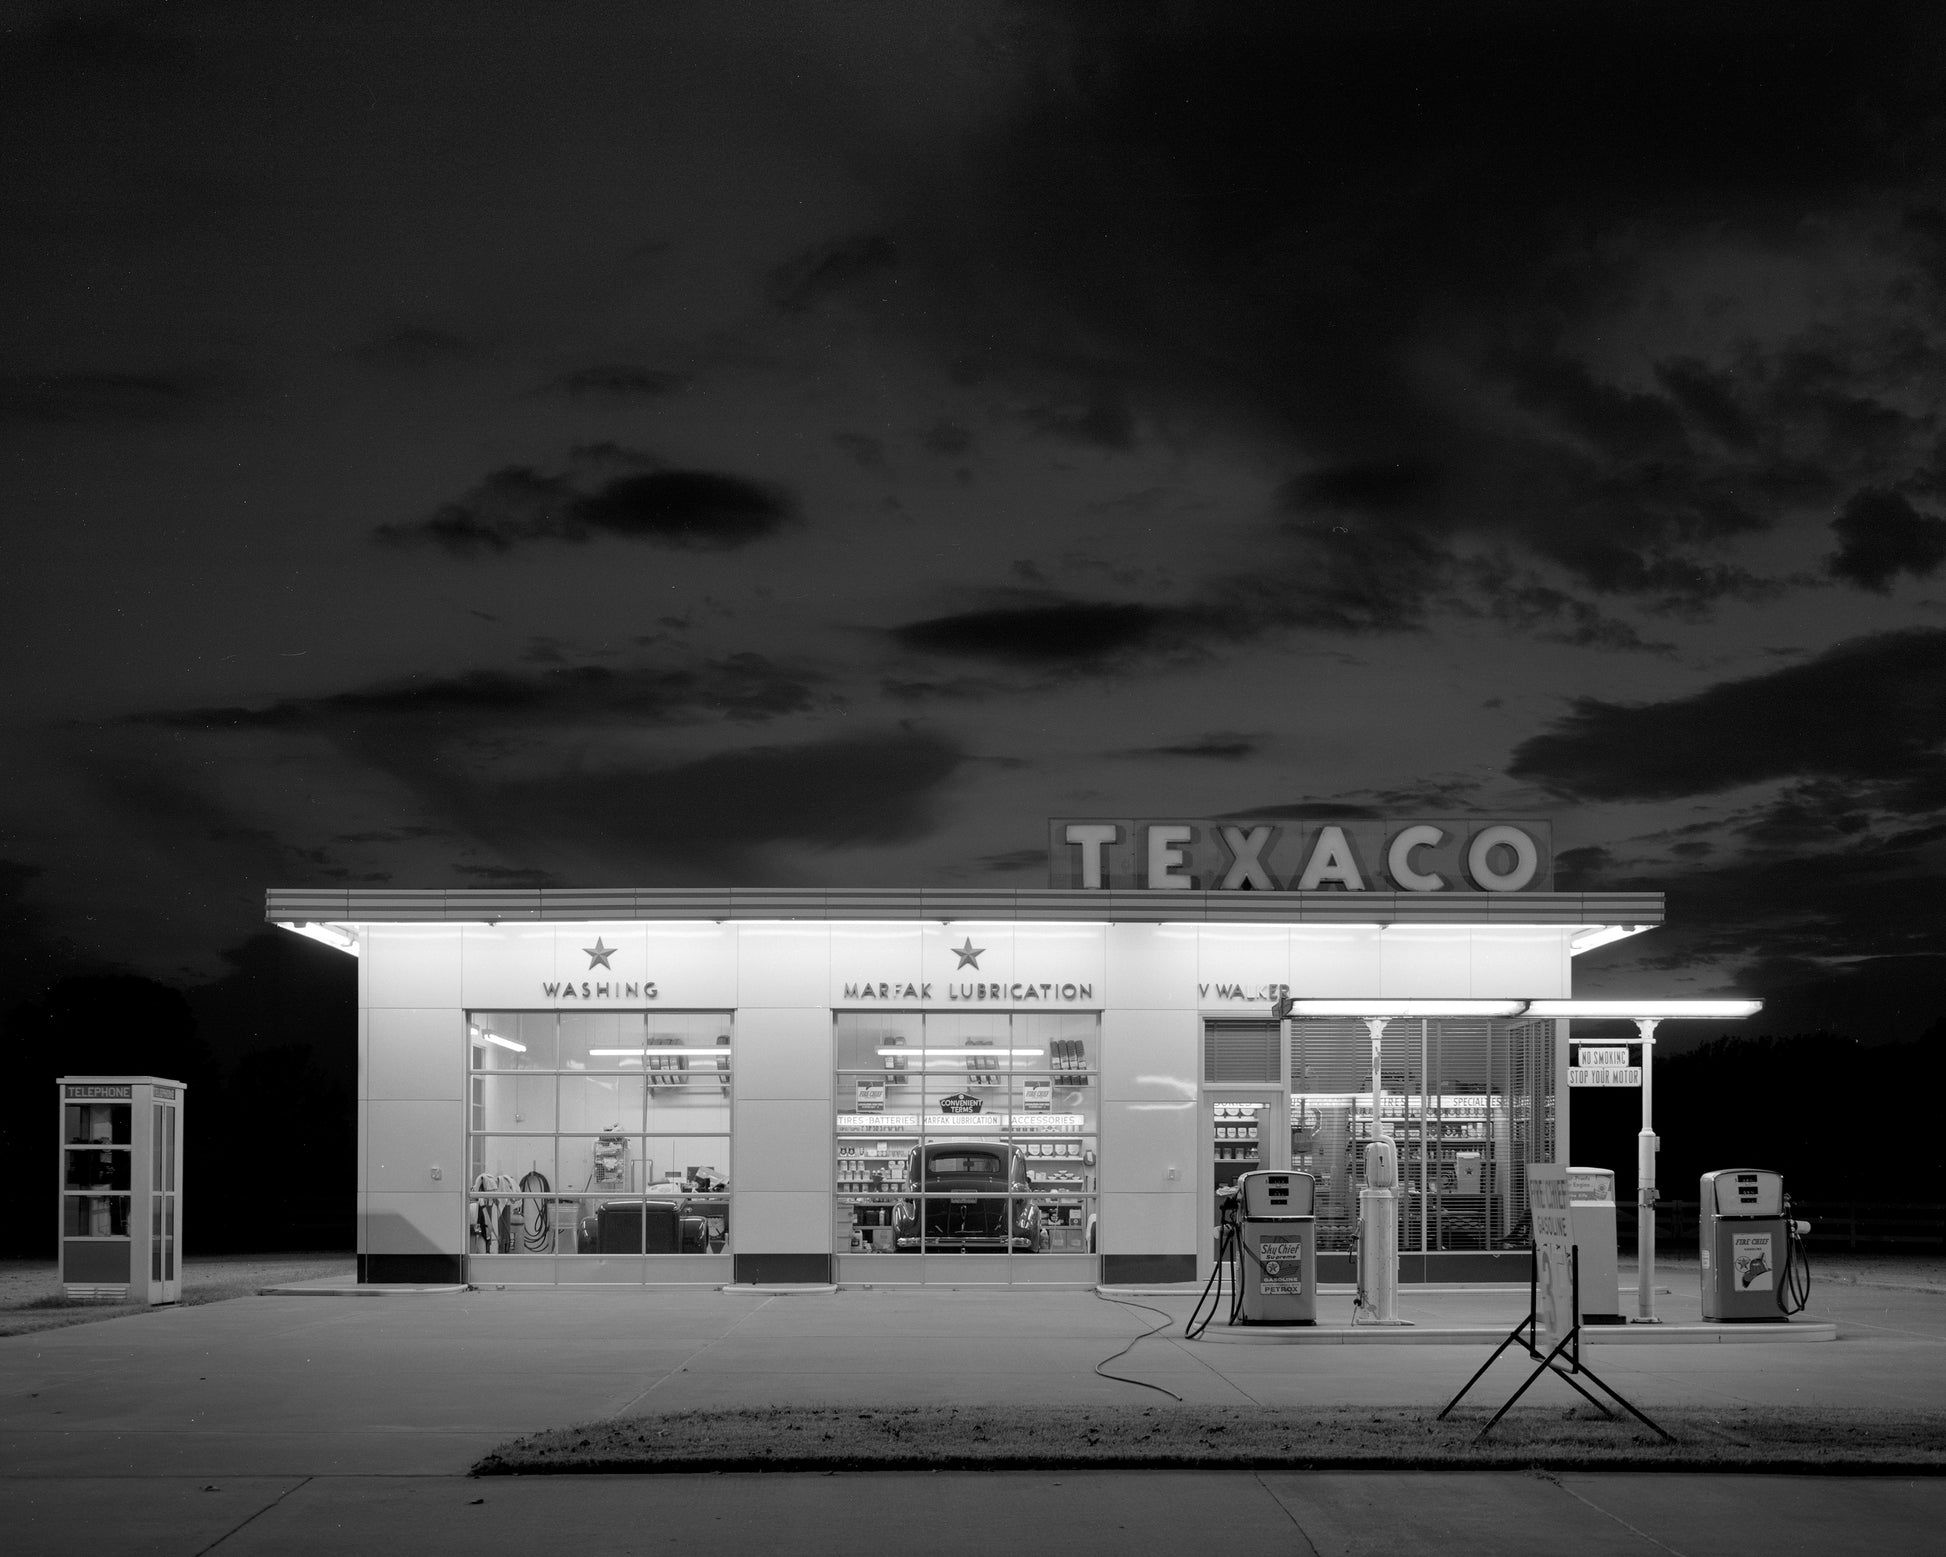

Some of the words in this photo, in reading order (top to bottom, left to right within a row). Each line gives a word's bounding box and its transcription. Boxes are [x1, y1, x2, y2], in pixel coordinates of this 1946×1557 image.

[1065, 825, 1538, 892] TEXACO
[543, 982, 658, 998] WASHING
[844, 982, 932, 999] MARFAK
[949, 983, 1092, 1000] LUBRICATION
[1199, 983, 1210, 999] V
[1216, 983, 1290, 1000] WALKER
[1582, 1051, 1591, 1064] NO
[1594, 1051, 1626, 1065] SMOKING
[1570, 1070, 1588, 1084] STOP
[1592, 1070, 1609, 1084] YOUR
[1613, 1070, 1638, 1084] MOTOR
[68, 1087, 130, 1097] TELEPHONE
[1380, 1097, 1406, 1106] IRES
[952, 1116, 998, 1125] LUBRICATION
[1012, 1116, 1075, 1125] ACCESSORIES
[1261, 1244, 1277, 1255] Sky
[1278, 1243, 1301, 1254] Chief
